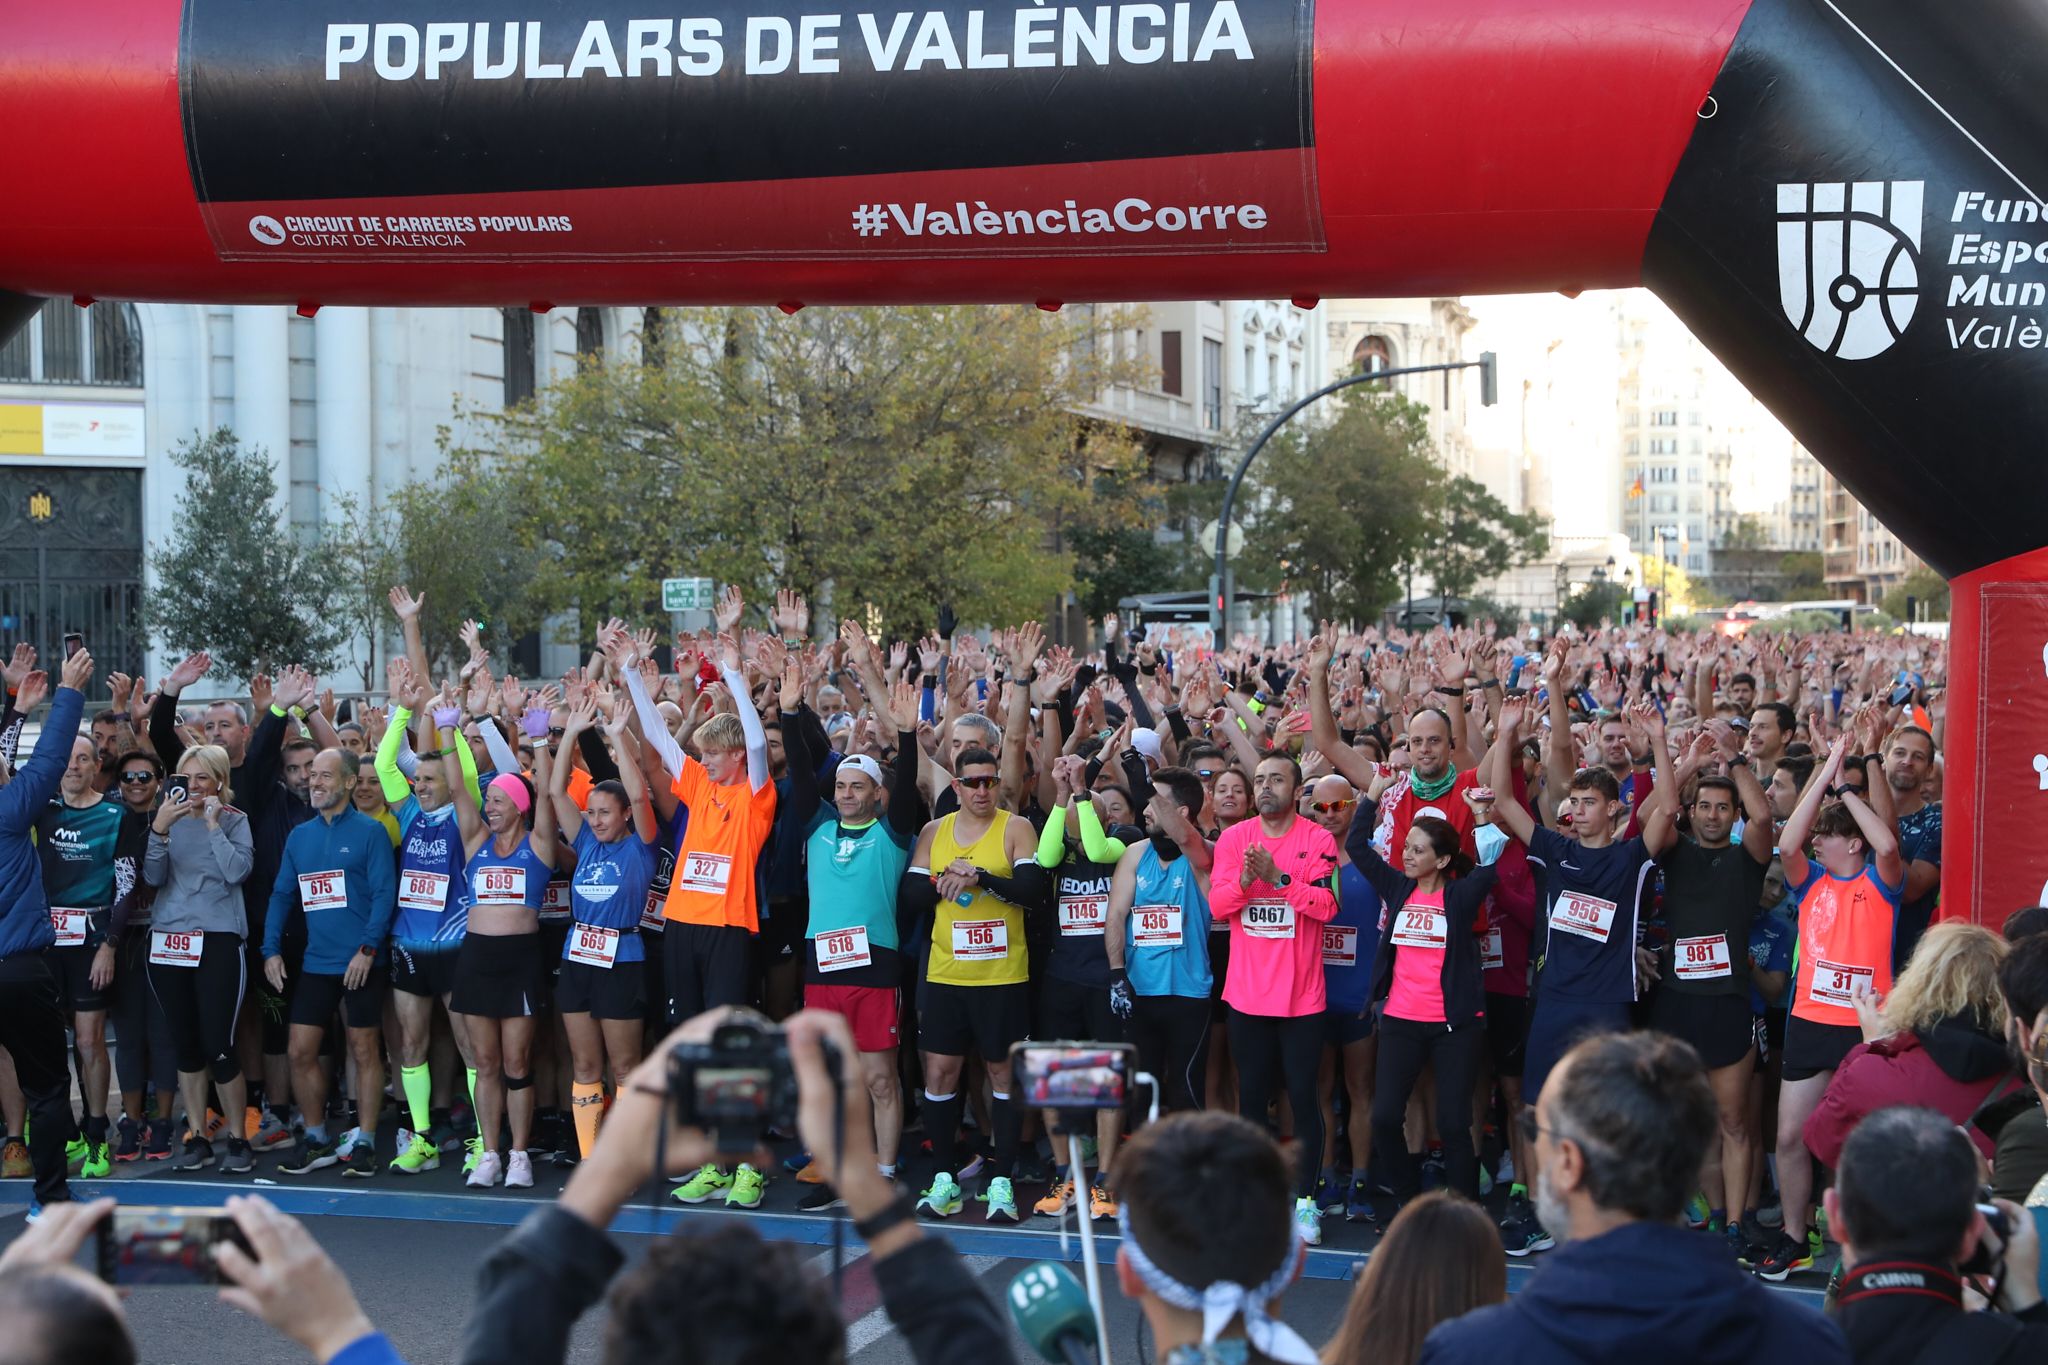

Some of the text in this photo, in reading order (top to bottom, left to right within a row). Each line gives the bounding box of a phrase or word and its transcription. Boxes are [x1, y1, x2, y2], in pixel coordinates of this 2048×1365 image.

[325, 0, 1255, 81] POPULARS DE VALÈNCIA
[284, 215, 573, 232] CIRCUIT DE CARRERES POPULARS
[852, 197, 1267, 237] #ValènciaCorre
[292, 232, 467, 247] CIUTAT DE VALÈNCIA
[1946, 314, 2048, 349] Valè
[694, 860, 719, 877] 327
[311, 879, 333, 896] 675
[410, 878, 436, 896] 688
[486, 874, 513, 890] 689
[1060, 876, 1113, 895] EDOLAT
[1067, 903, 1099, 920] 1146
[1248, 906, 1286, 923] 6467
[1568, 900, 1601, 923] 956
[1142, 913, 1169, 930] 436
[1405, 912, 1434, 931] 226
[164, 934, 191, 951] 499
[580, 932, 607, 951] 669
[828, 935, 854, 955] 618
[966, 928, 993, 945] 156
[1323, 933, 1345, 950] 56
[1686, 944, 1715, 963] 981
[1832, 971, 1853, 991] 31
[1862, 1272, 1925, 1289] Canon
